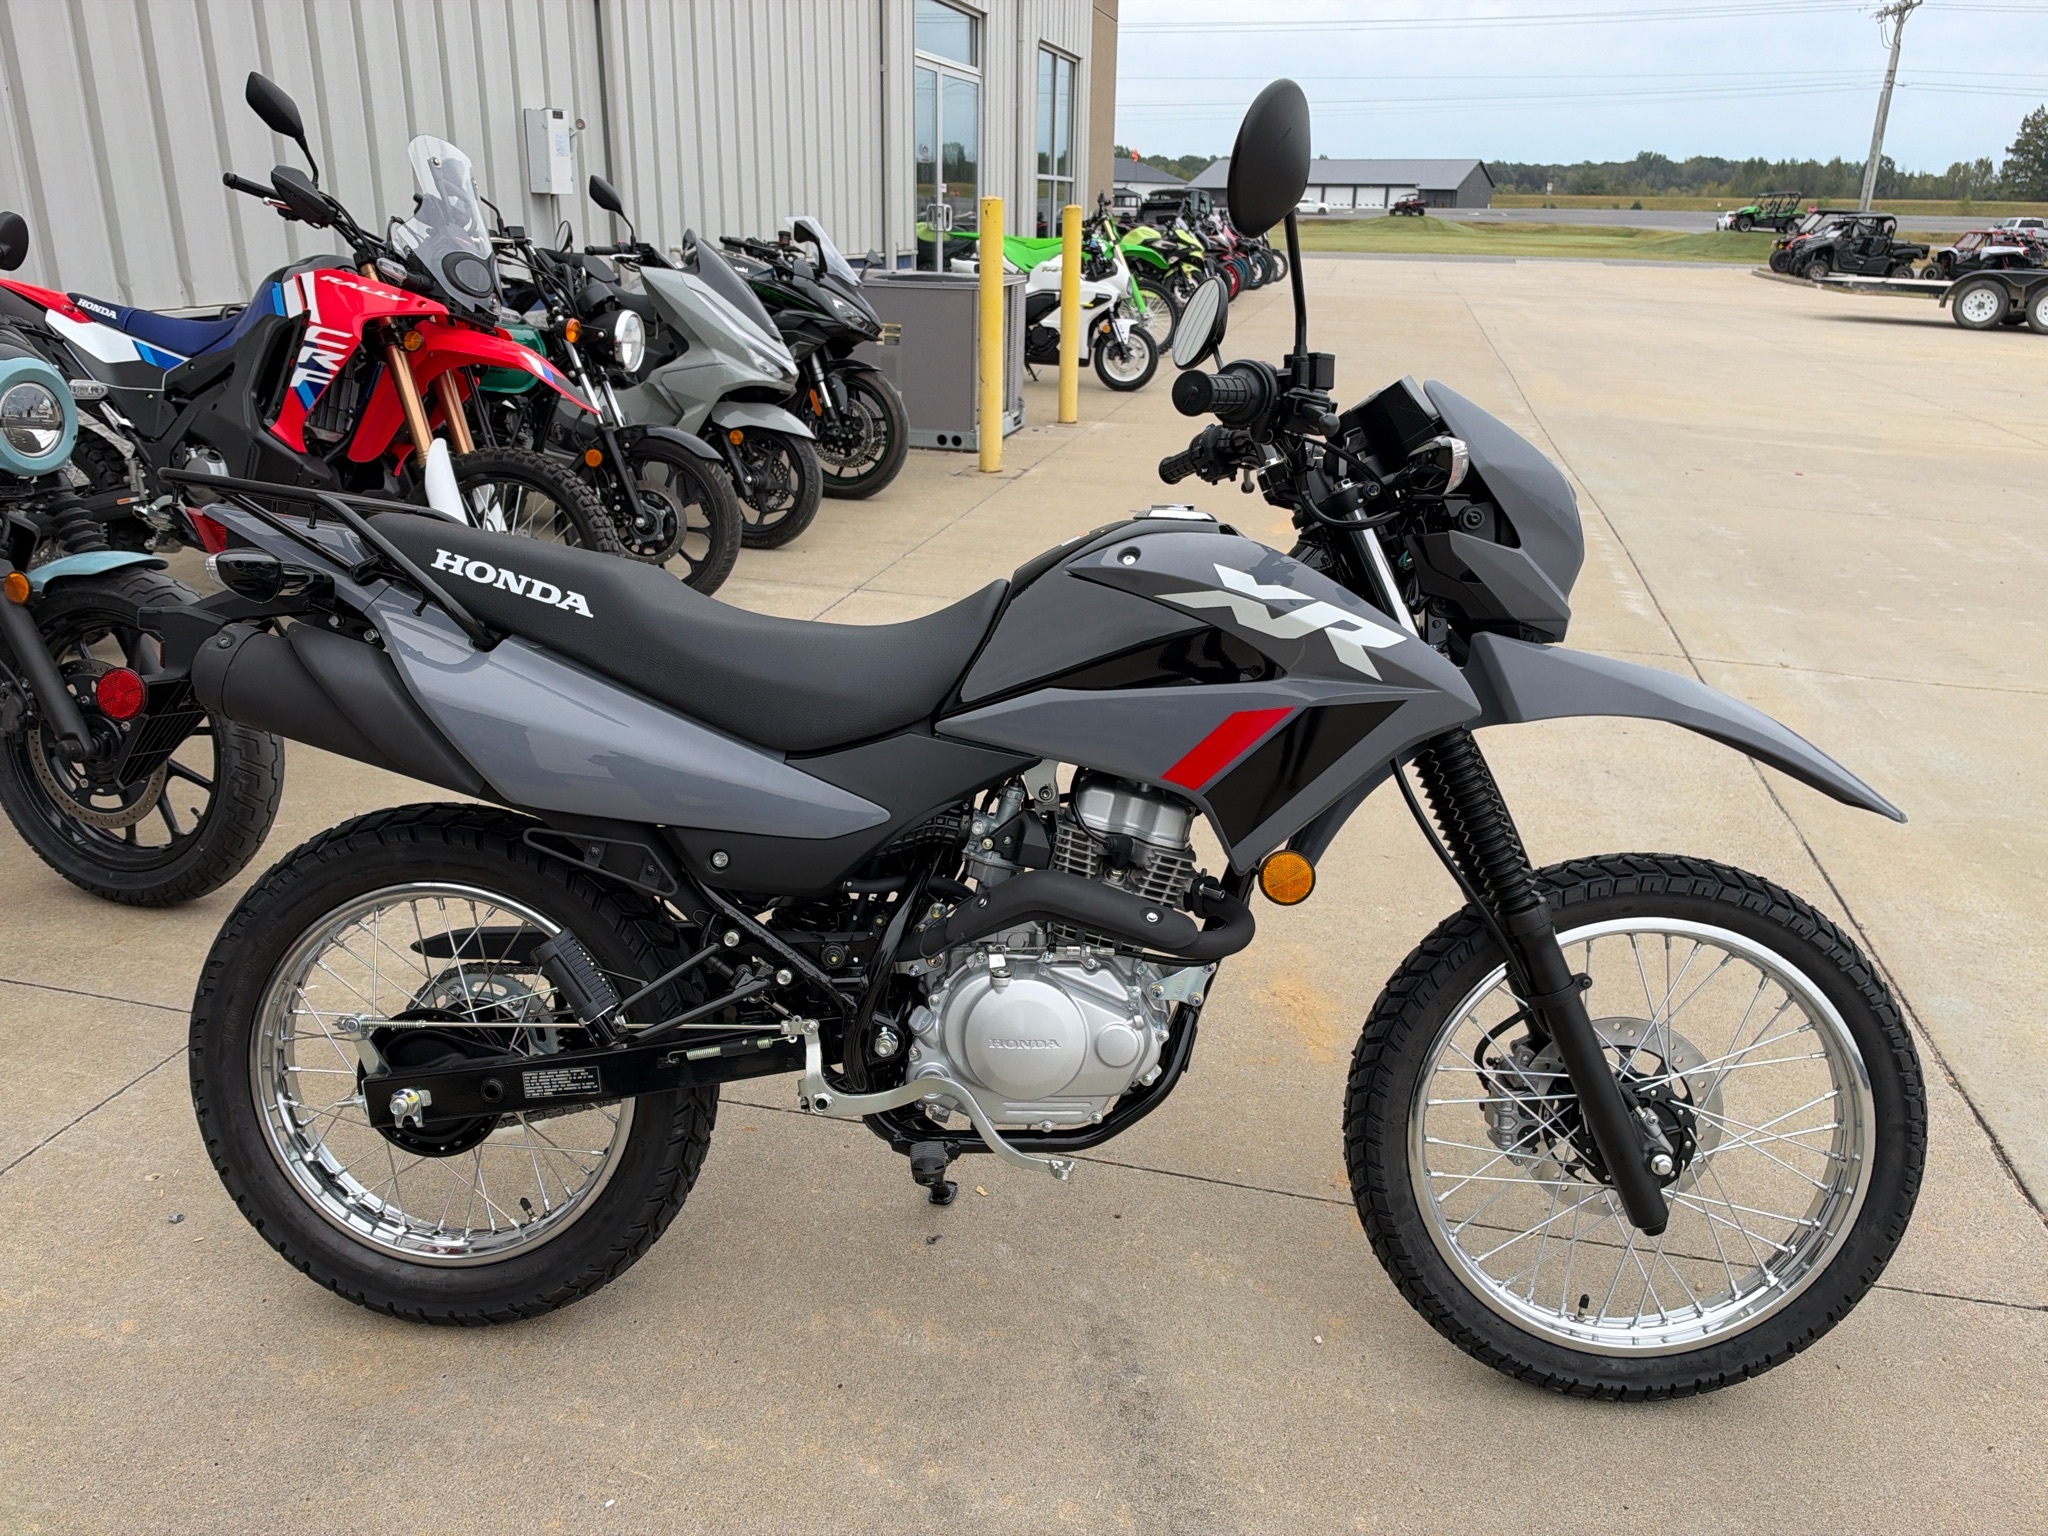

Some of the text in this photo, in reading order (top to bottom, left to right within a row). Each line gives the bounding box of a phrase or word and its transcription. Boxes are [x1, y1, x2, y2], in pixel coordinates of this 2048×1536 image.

[320, 275, 409, 301] RALLY
[77, 298, 117, 320] HONDA
[290, 325, 353, 387] CRF
[431, 549, 594, 618] HONDA
[988, 1038, 1061, 1050] HONDA
